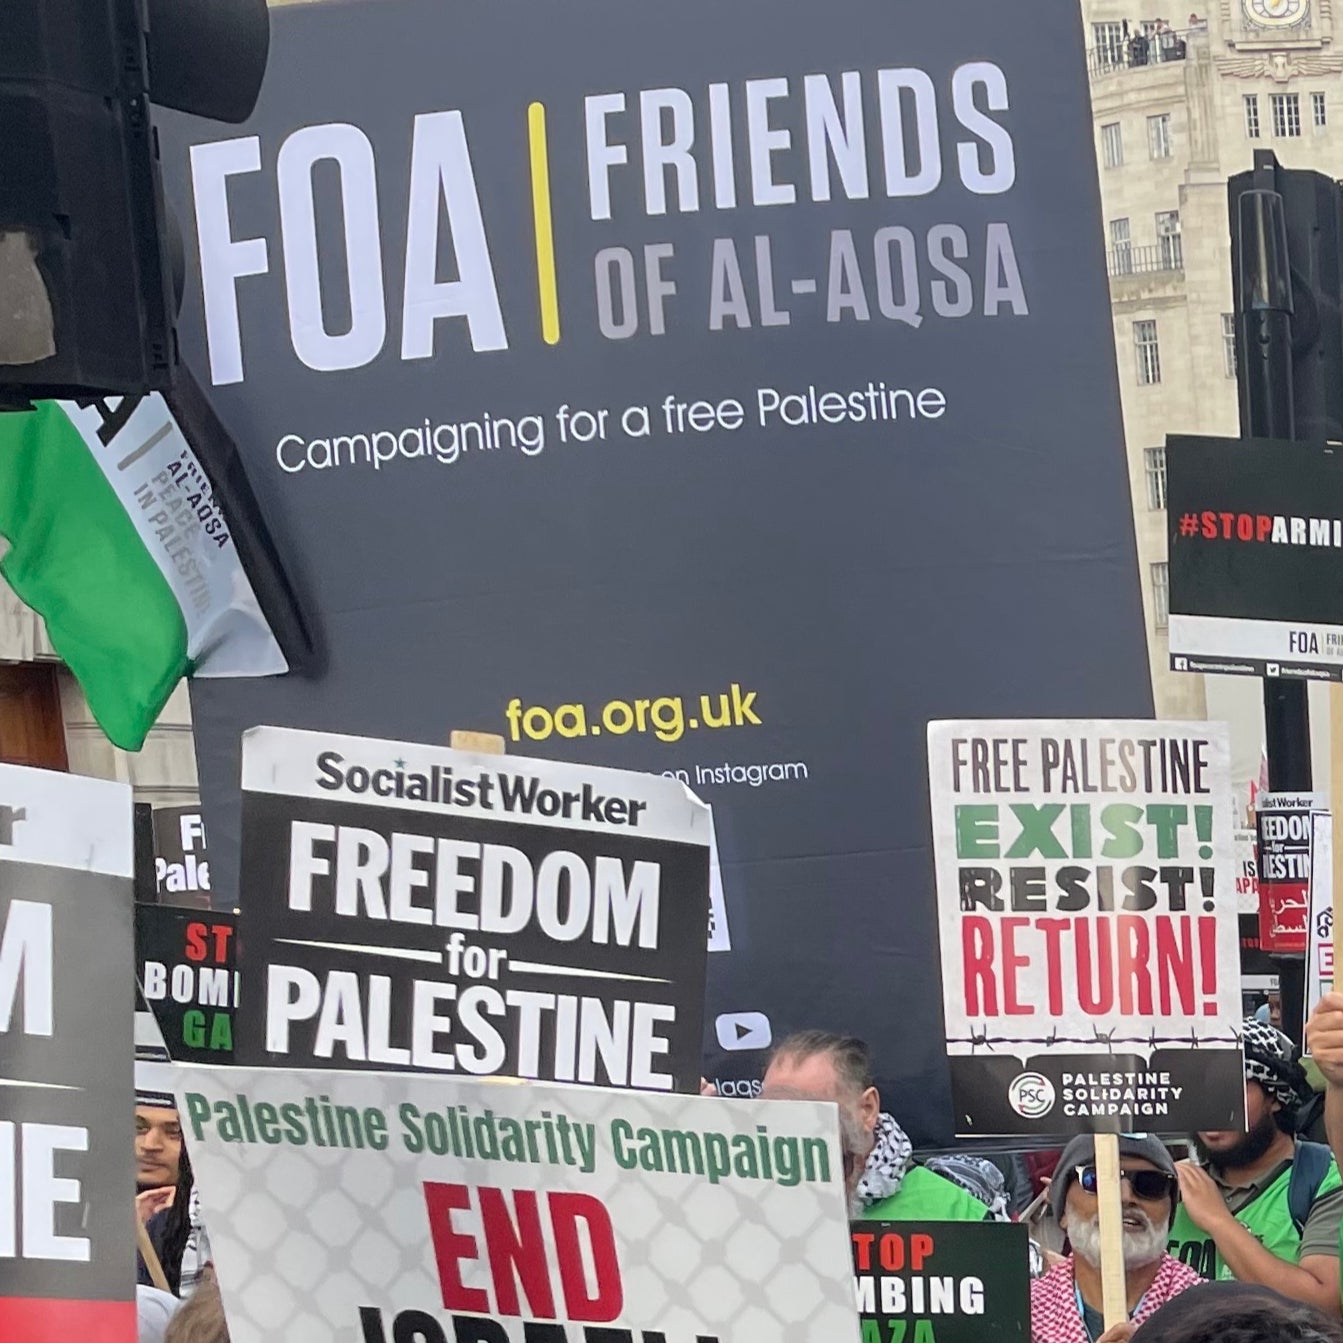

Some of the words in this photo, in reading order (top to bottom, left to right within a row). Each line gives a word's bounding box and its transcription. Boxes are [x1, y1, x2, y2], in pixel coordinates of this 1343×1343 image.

[585, 62, 1017, 221] FRIENDS
[190, 109, 508, 386] FOA
[595, 240, 677, 340] OF
[708, 222, 1030, 329] AL-AQSA
[276, 409, 545, 474] Campaigning
[556, 402, 609, 444] for
[622, 410, 649, 437] a
[663, 395, 744, 434] free
[757, 380, 946, 426] Palestine
[1289, 631, 1319, 654] FOA
[506, 683, 762, 743] foa.org.uk
[695, 761, 809, 787] Instagram
[951, 738, 1028, 794] FREE
[1042, 737, 1211, 794] PALESTINE
[955, 804, 1214, 860] EXIST!
[290, 820, 661, 950] FREEDOM
[960, 867, 1216, 912] RESIST!
[447, 933, 507, 981] for
[963, 914, 1218, 1018] RETURN!
[266, 963, 675, 1090] PALESTINE
[1062, 1071, 1171, 1087] PALESTINE
[1062, 1086, 1183, 1101] SOLIDARITY
[1062, 1100, 1168, 1118] CAMPAIGN
[184, 1092, 388, 1152] Palestine
[399, 1103, 596, 1173] Solidarity
[609, 1117, 832, 1187] Campaign
[422, 1182, 624, 1322] END
[853, 1233, 934, 1271] TOP
[854, 1276, 985, 1315] MBING
